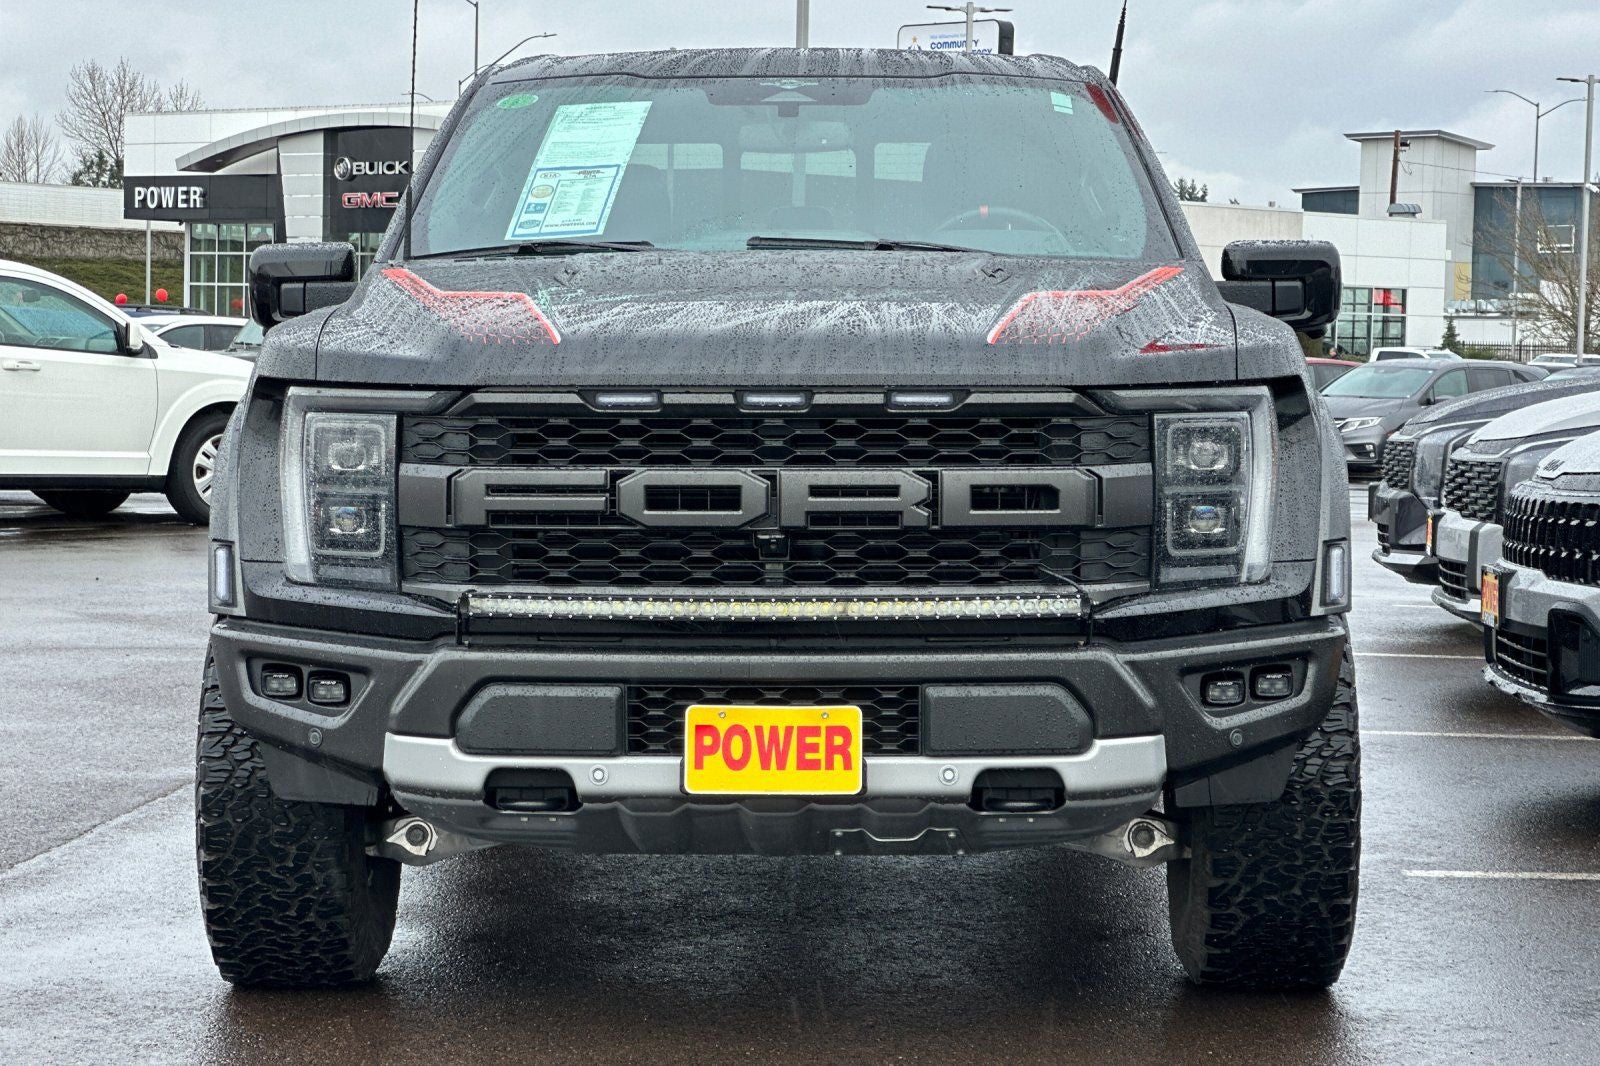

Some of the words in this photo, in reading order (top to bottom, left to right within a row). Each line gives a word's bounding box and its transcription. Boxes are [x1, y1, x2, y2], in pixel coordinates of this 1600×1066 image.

[352, 161, 409, 175] BUICK
[134, 186, 203, 209] POWER
[342, 192, 399, 208] GMC
[452, 466, 1100, 529] FORD
[694, 724, 853, 771] POWER
